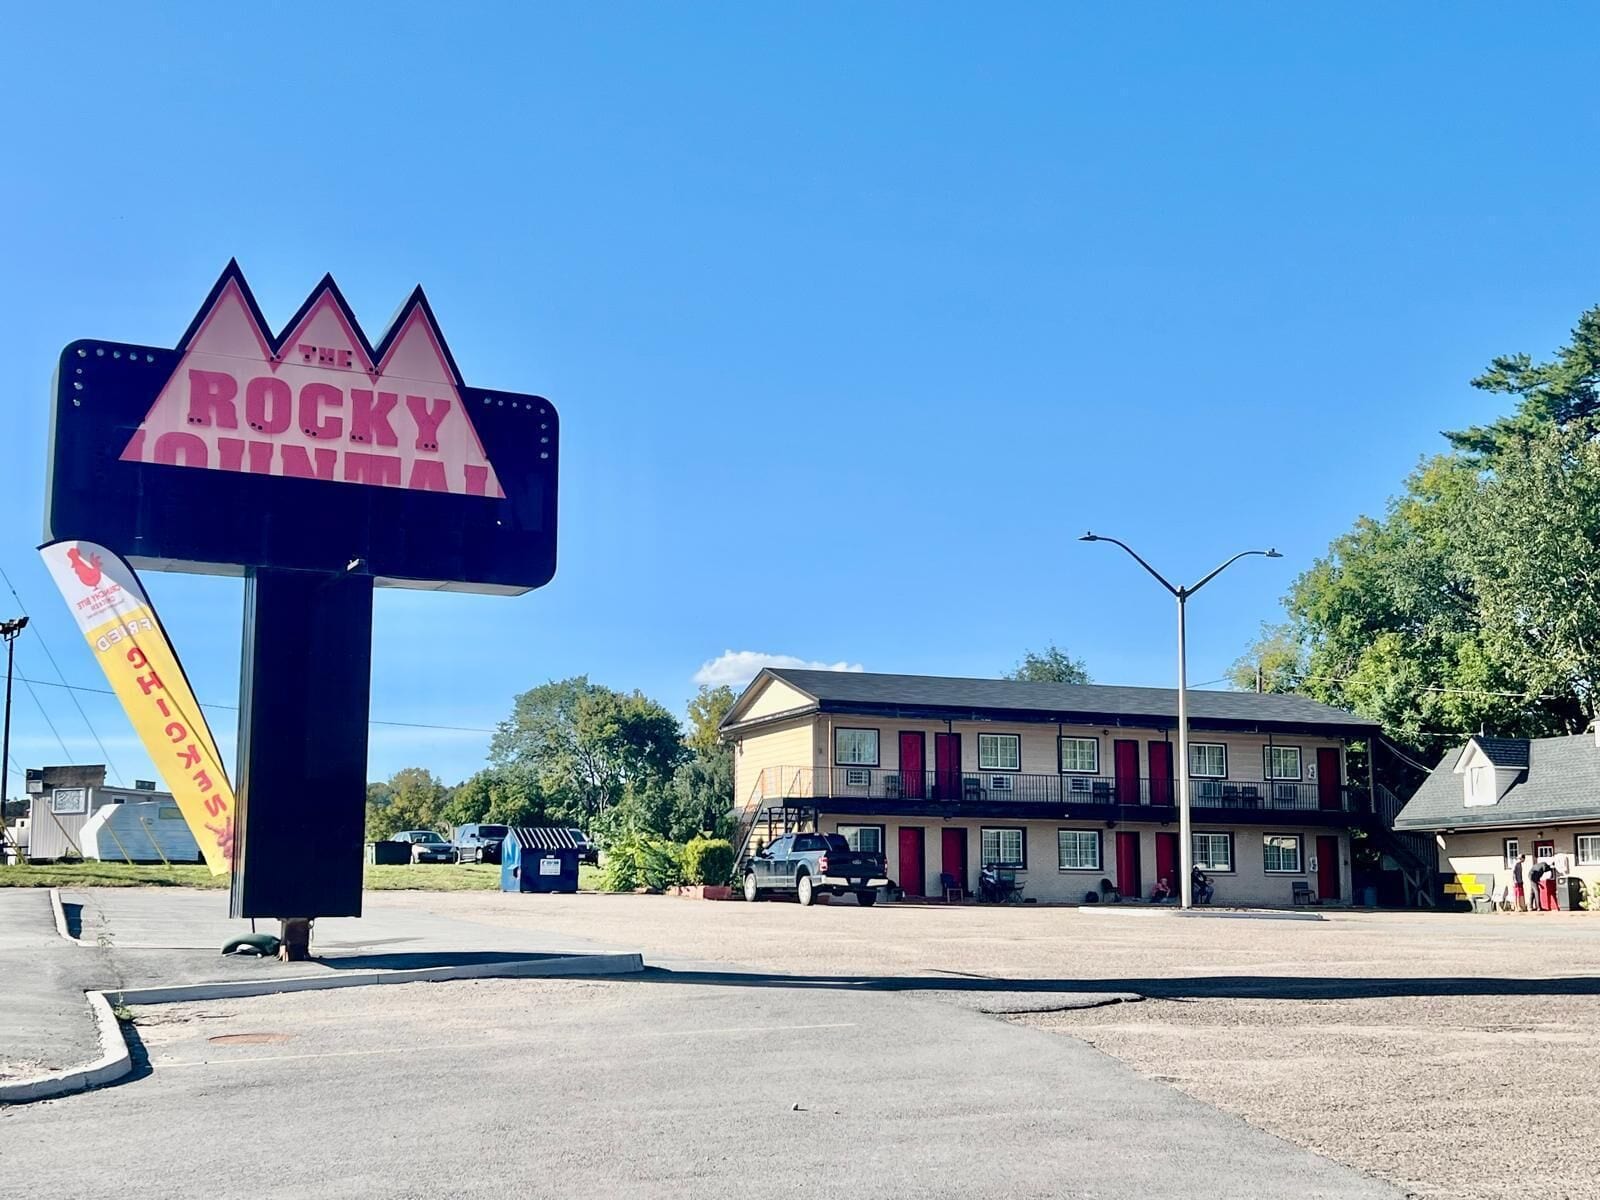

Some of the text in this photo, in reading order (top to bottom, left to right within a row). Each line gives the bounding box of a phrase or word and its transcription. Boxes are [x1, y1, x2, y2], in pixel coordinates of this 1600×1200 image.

[298, 344, 352, 368] THE
[188, 369, 451, 452] ROCKY
[119, 428, 507, 498] OUNTAI
